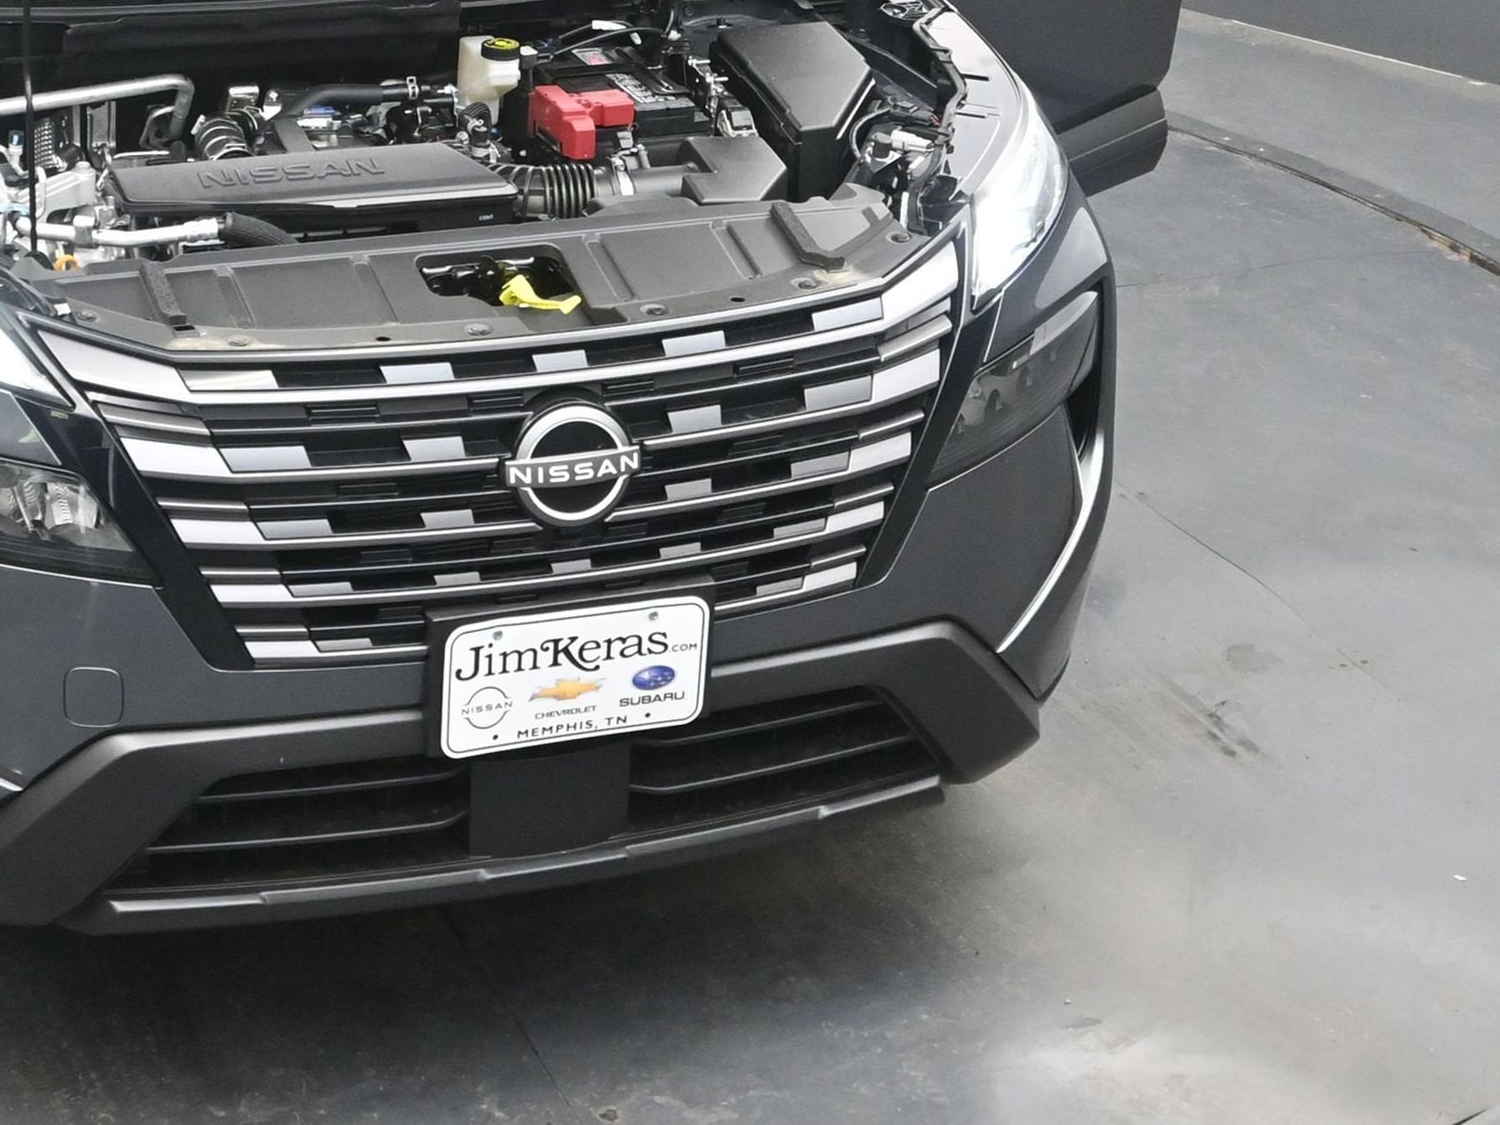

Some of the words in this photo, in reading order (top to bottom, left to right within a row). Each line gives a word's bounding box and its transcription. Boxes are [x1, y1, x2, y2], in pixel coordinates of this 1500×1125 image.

[197, 157, 385, 189] NISSAN
[508, 451, 639, 485] NISSAN
[461, 700, 513, 716] NISSAN
[619, 691, 685, 707] SUBARU
[534, 705, 597, 720] CHEVROLET
[517, 719, 598, 739] MEMPHIS,
[604, 715, 628, 726] TN
